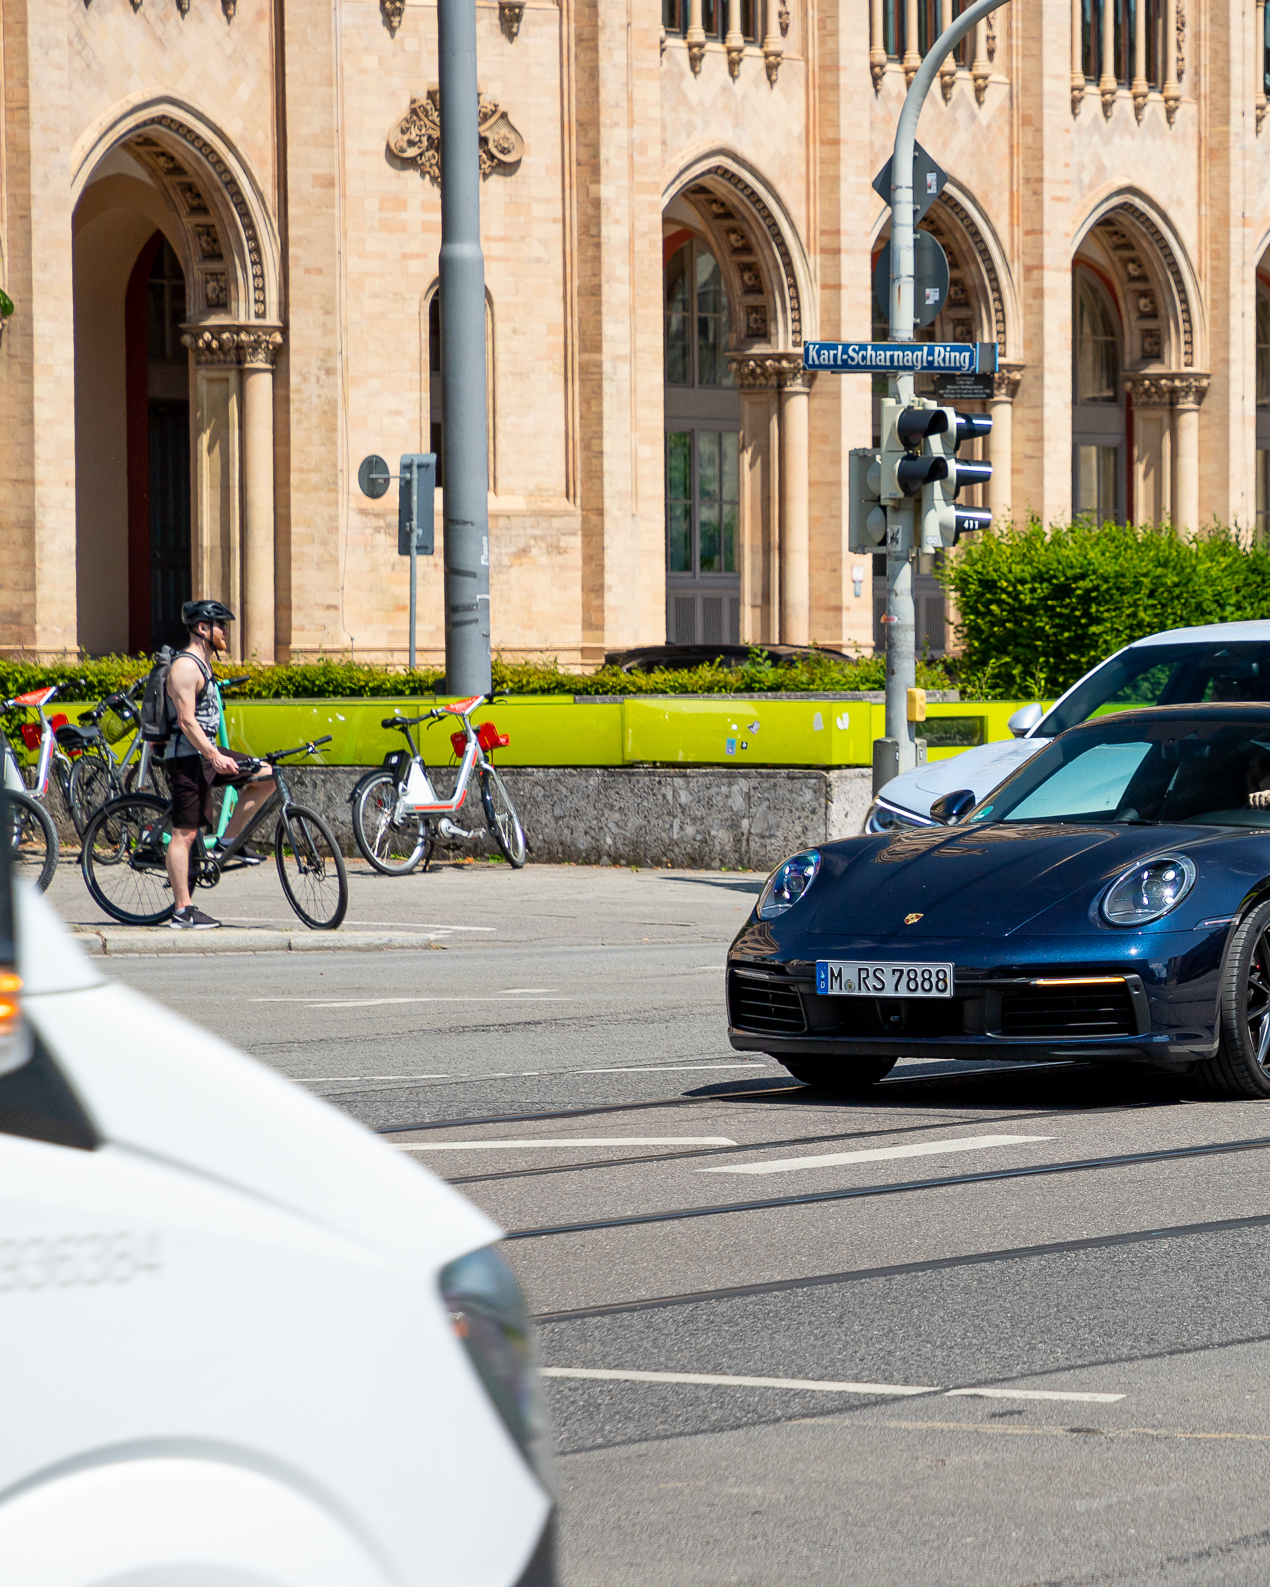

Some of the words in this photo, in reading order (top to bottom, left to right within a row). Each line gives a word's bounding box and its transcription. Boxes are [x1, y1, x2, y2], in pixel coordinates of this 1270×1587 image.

[808, 344, 971, 371] Karl-Scharnagl-Ring
[963, 519, 979, 530] 411
[829, 966, 843, 991] M
[858, 967, 886, 992] RS
[892, 968, 948, 993] 7888
